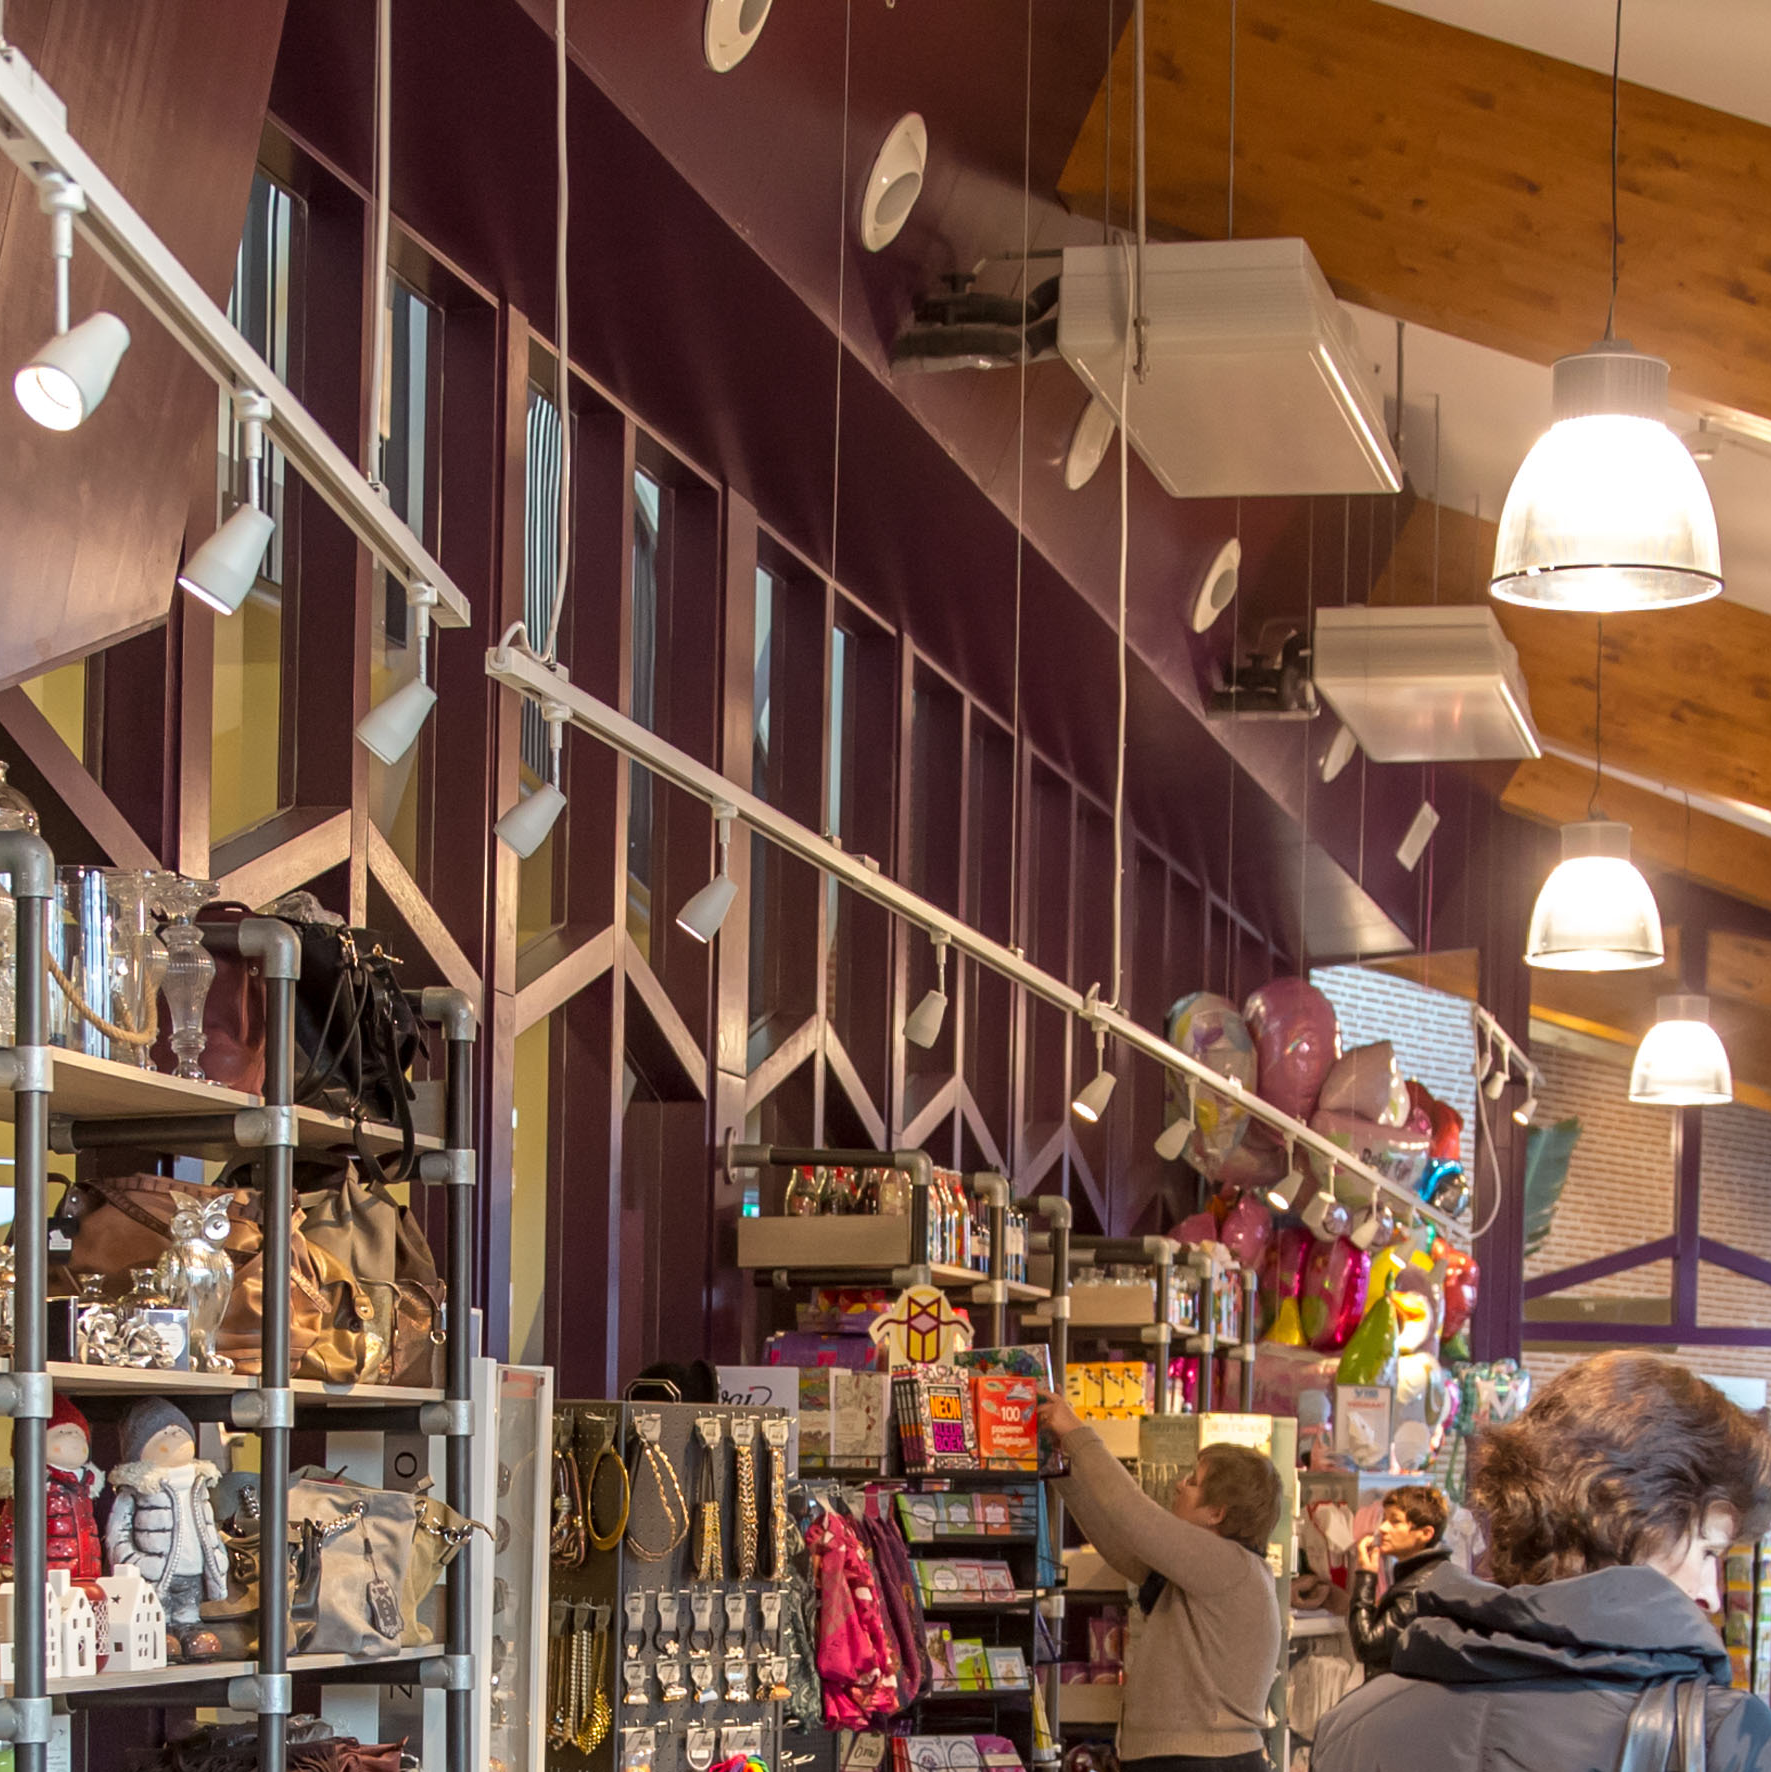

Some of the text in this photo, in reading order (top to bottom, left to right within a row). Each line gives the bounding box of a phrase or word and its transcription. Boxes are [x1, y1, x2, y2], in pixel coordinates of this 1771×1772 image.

[930, 1395, 961, 1420] NEON
[1001, 1406, 1021, 1422] 100
[933, 1423, 963, 1436] KLEUR
[935, 1435, 965, 1451] BOEK
